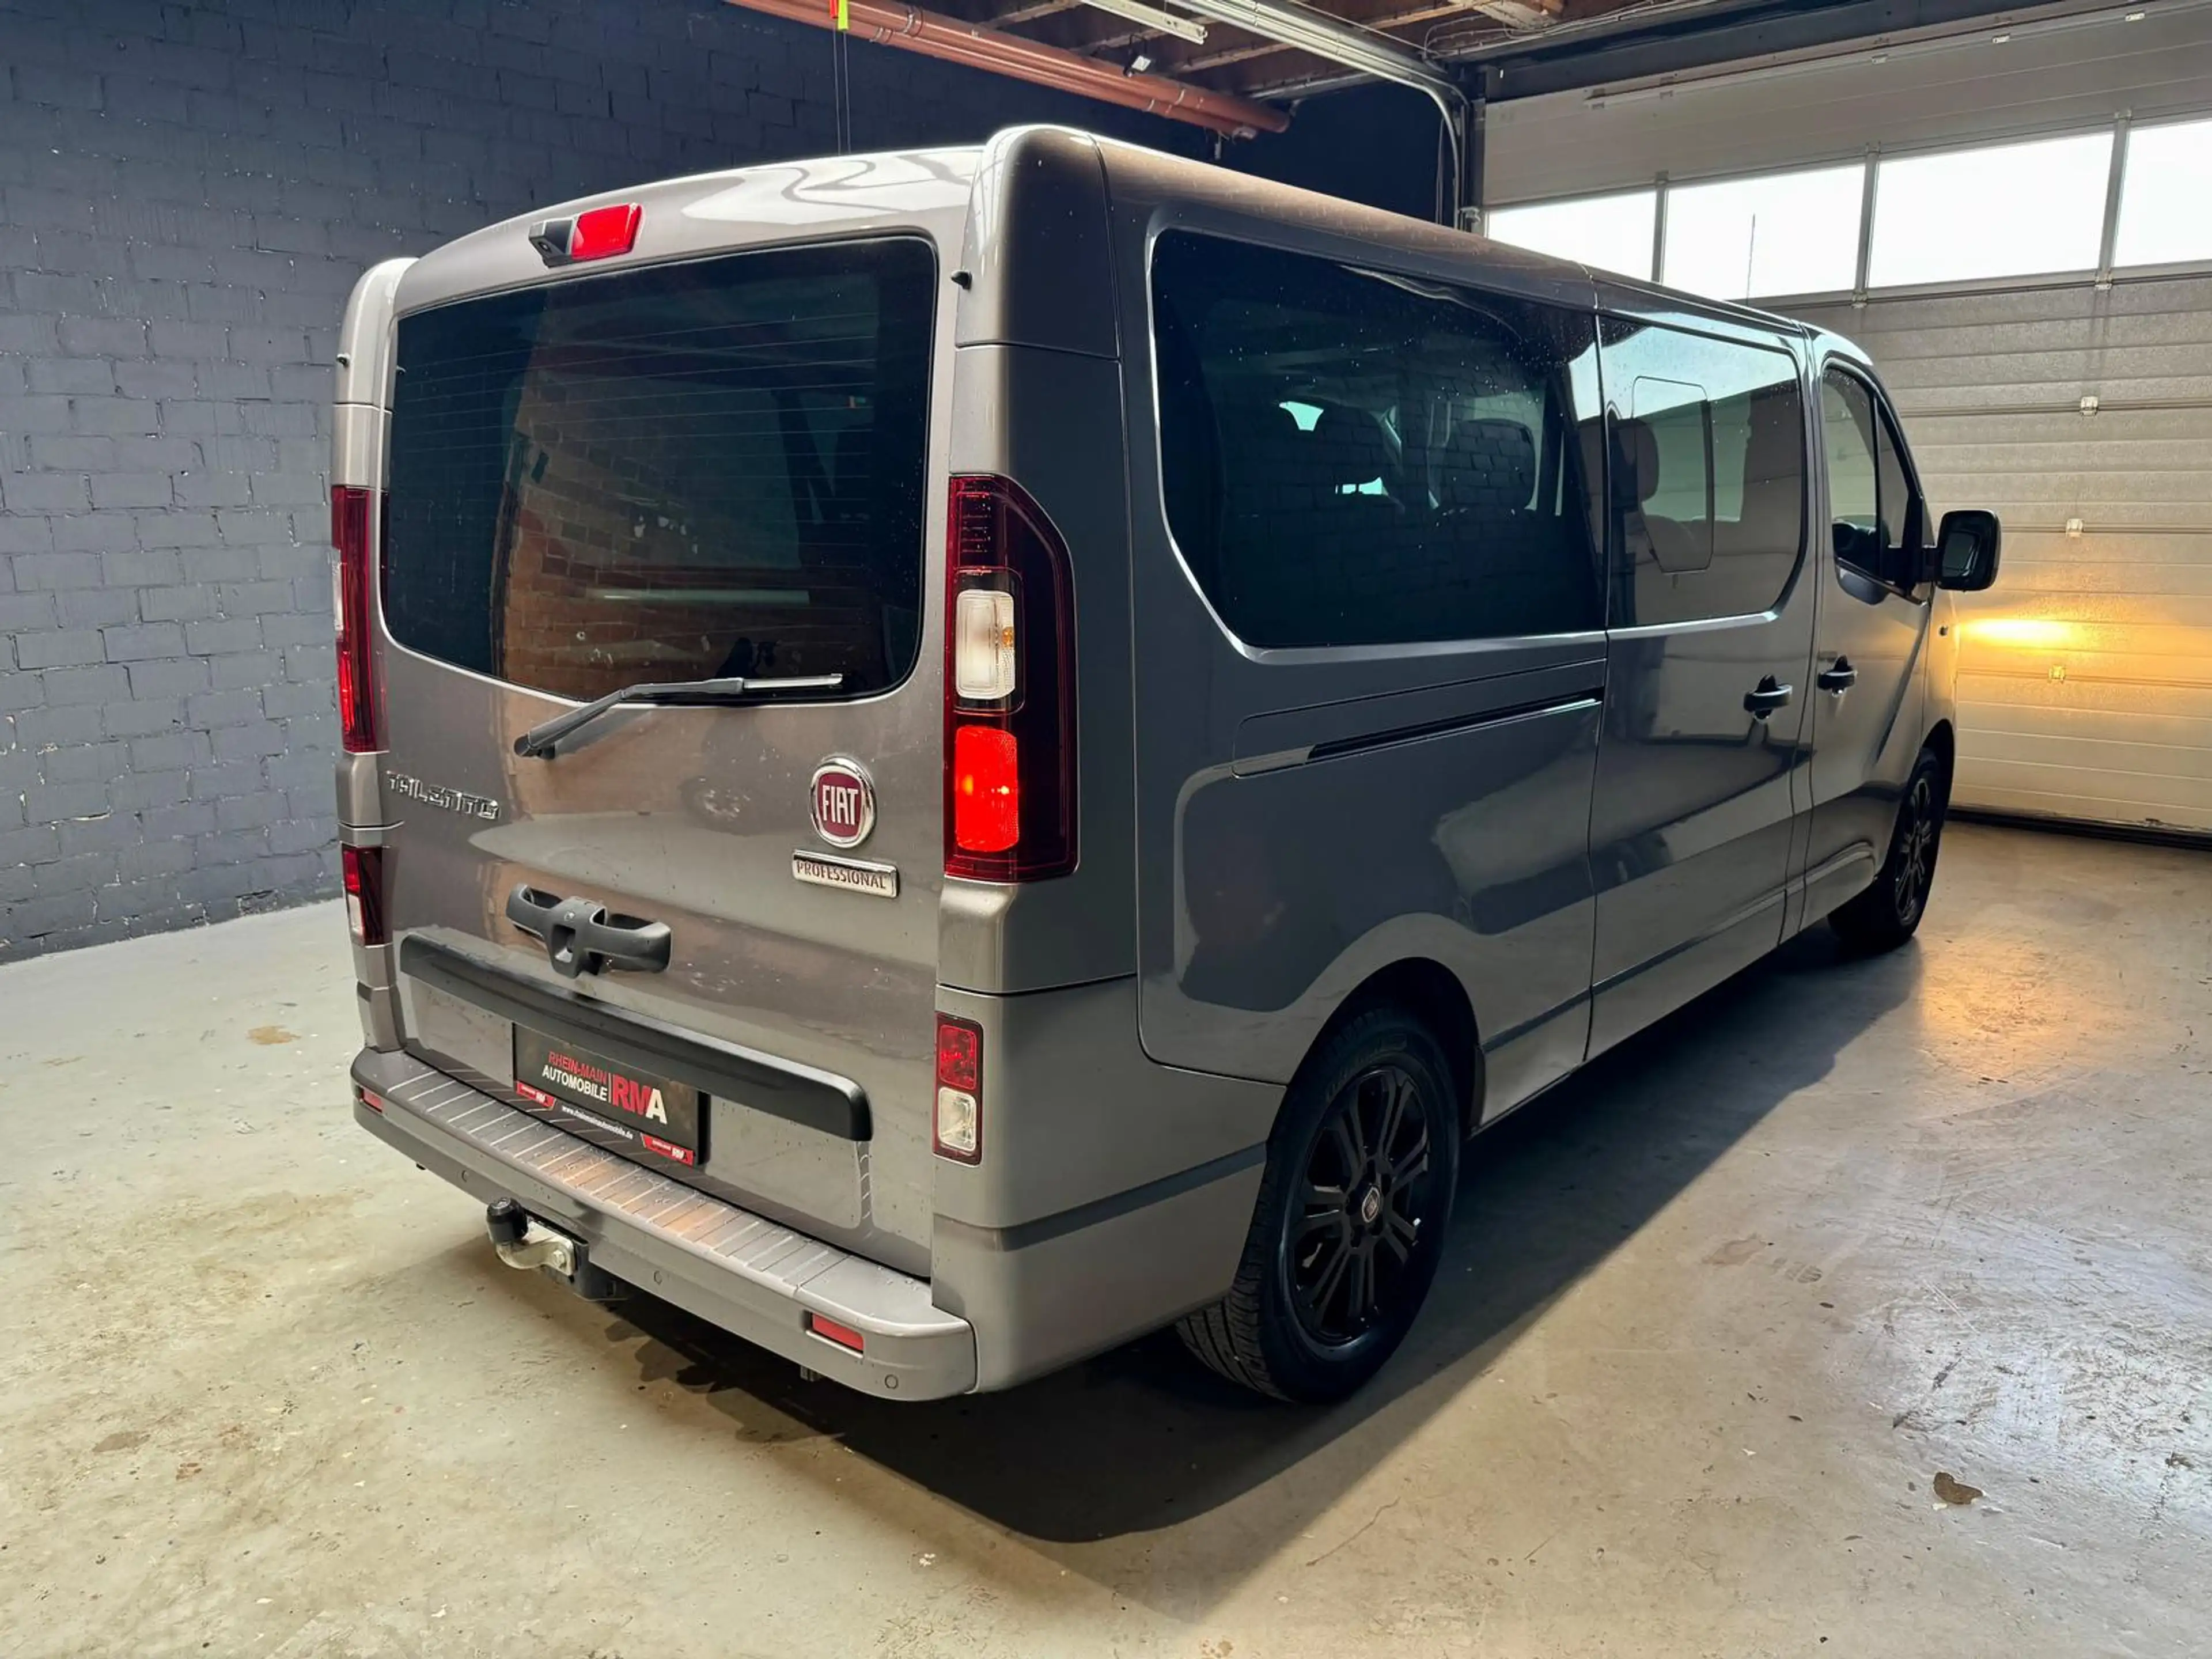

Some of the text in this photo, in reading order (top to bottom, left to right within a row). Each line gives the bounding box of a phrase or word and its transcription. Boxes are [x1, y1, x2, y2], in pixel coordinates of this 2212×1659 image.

[823, 785, 858, 825] FIAT
[797, 861, 886, 889] PROFESSIONAL
[542, 1065, 608, 1101] AUTOMOBILE
[548, 1051, 607, 1084] RHEIN-MAIN
[612, 1074, 668, 1124] RMA
